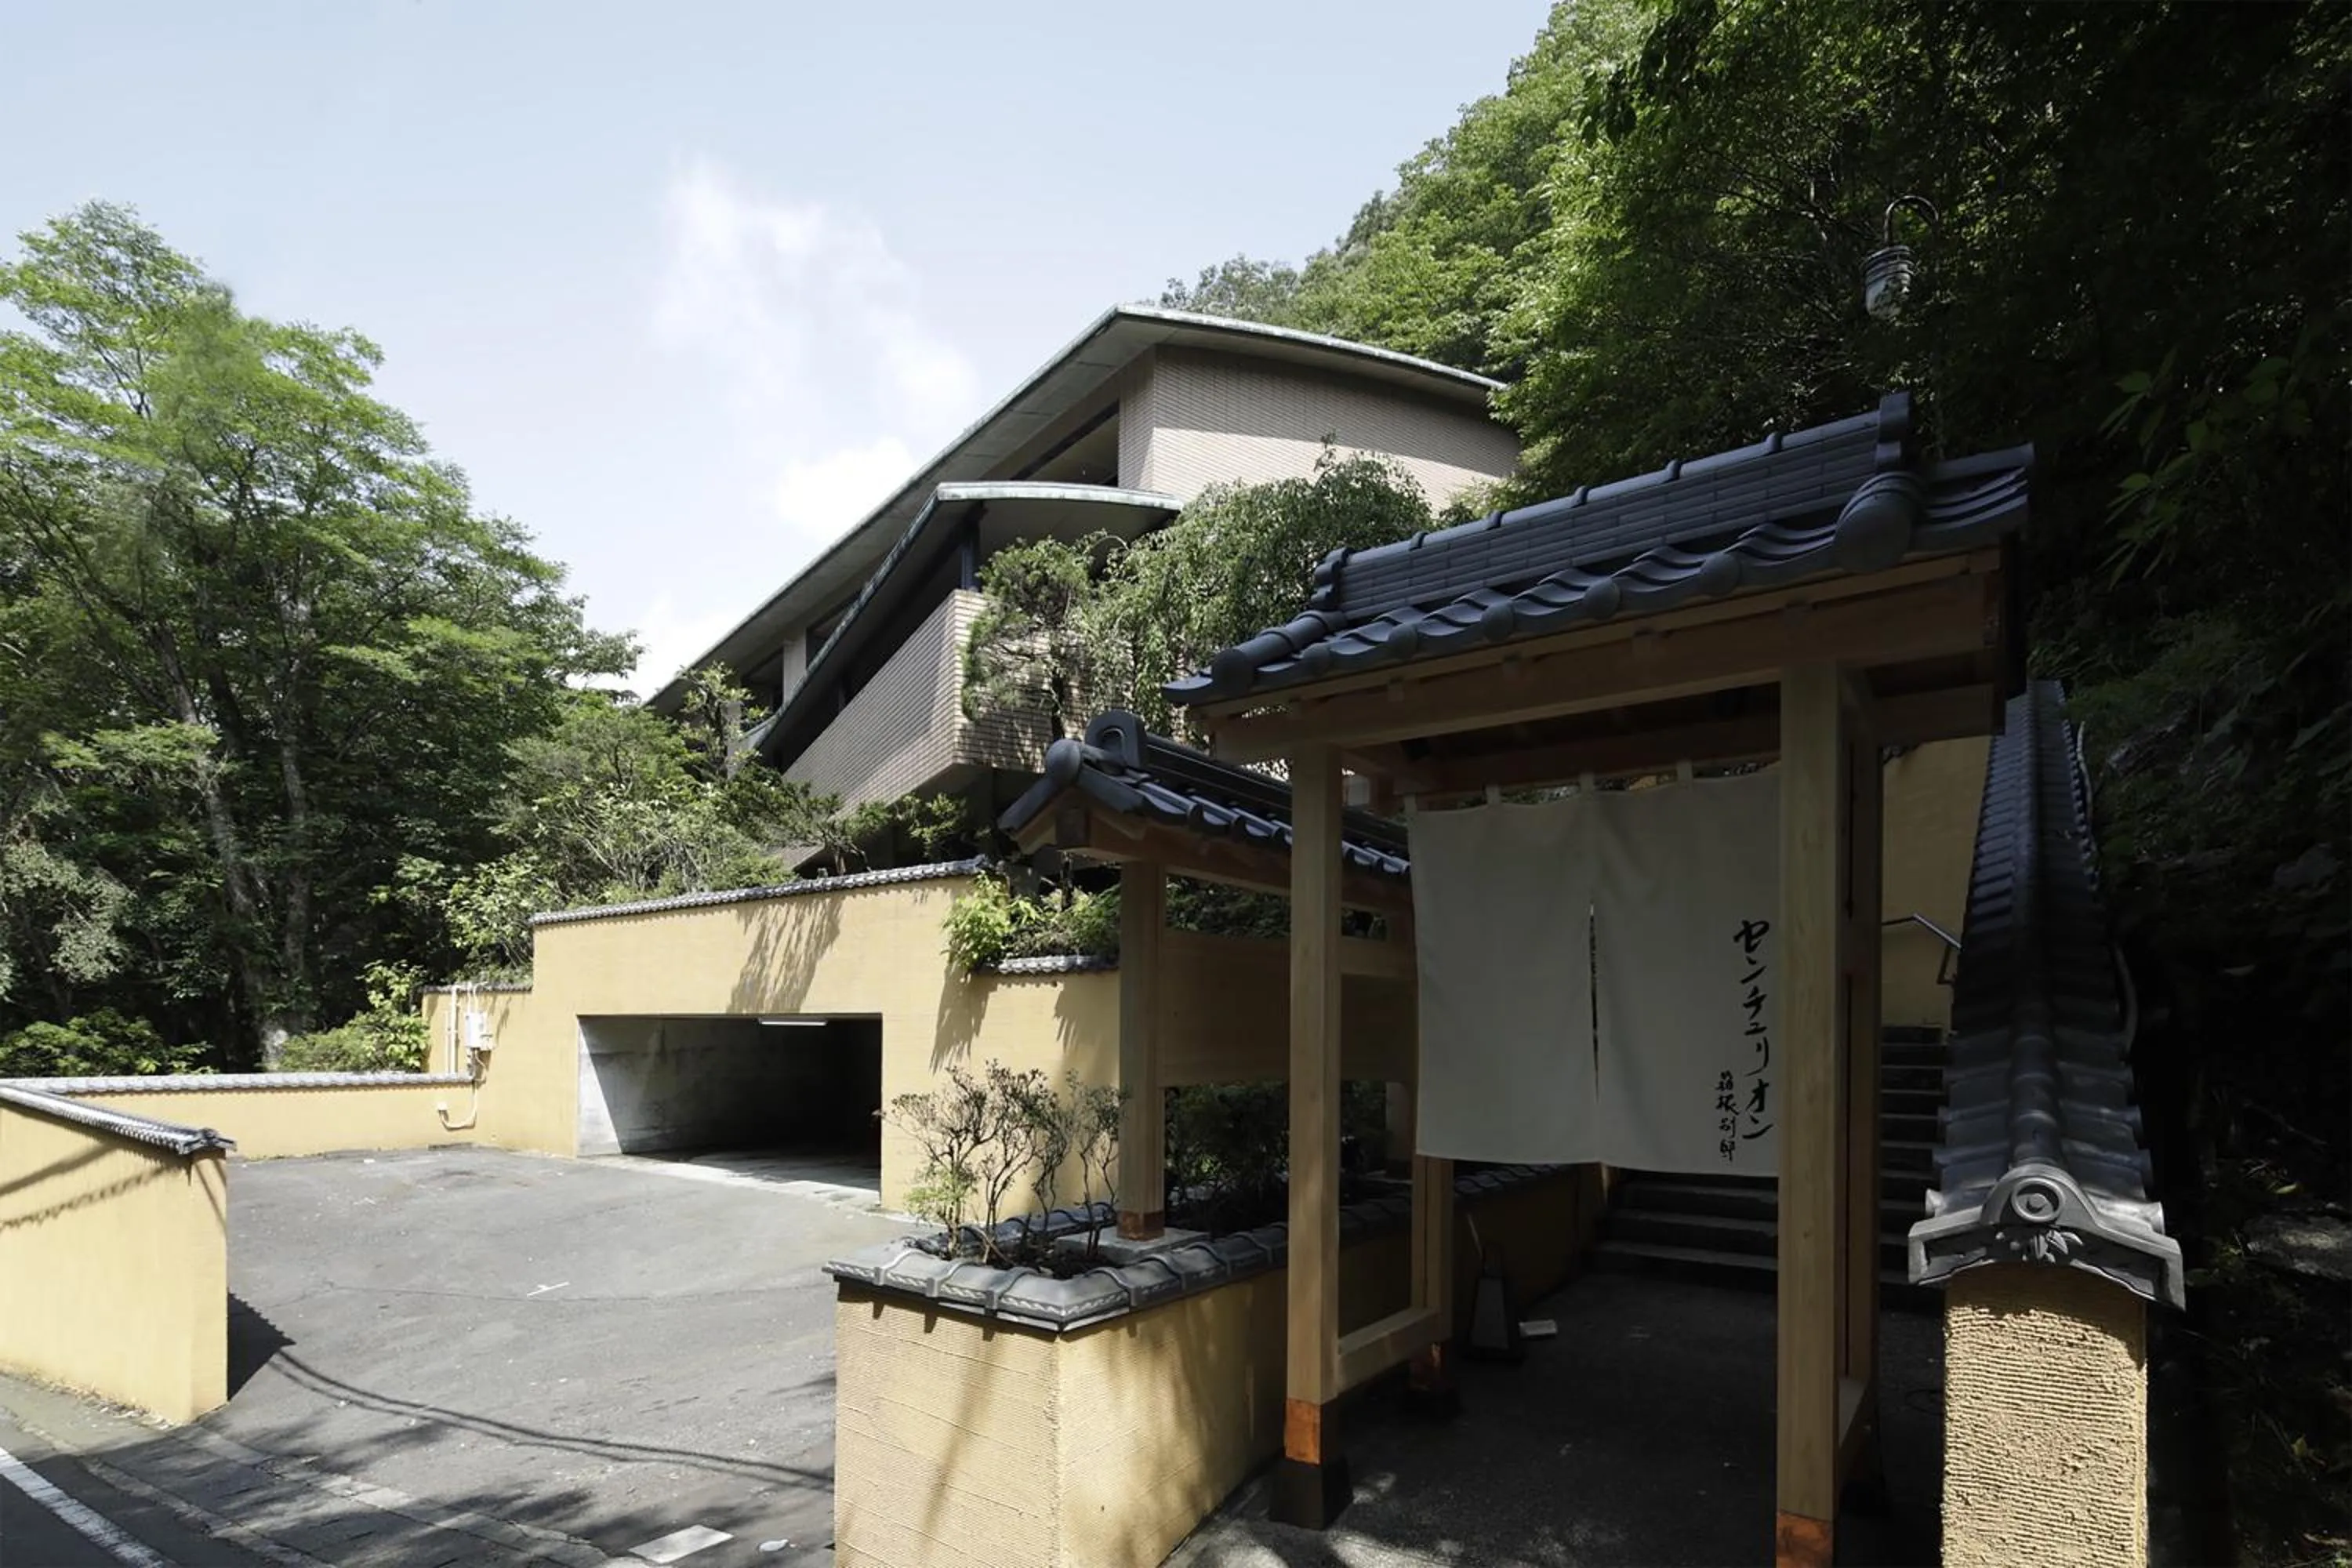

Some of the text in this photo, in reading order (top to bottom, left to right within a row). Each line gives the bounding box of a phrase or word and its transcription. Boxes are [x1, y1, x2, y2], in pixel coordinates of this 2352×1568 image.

[1733, 920, 1773, 1140] センチュリオン
[1715, 1070, 1740, 1162] 箱根別邸
